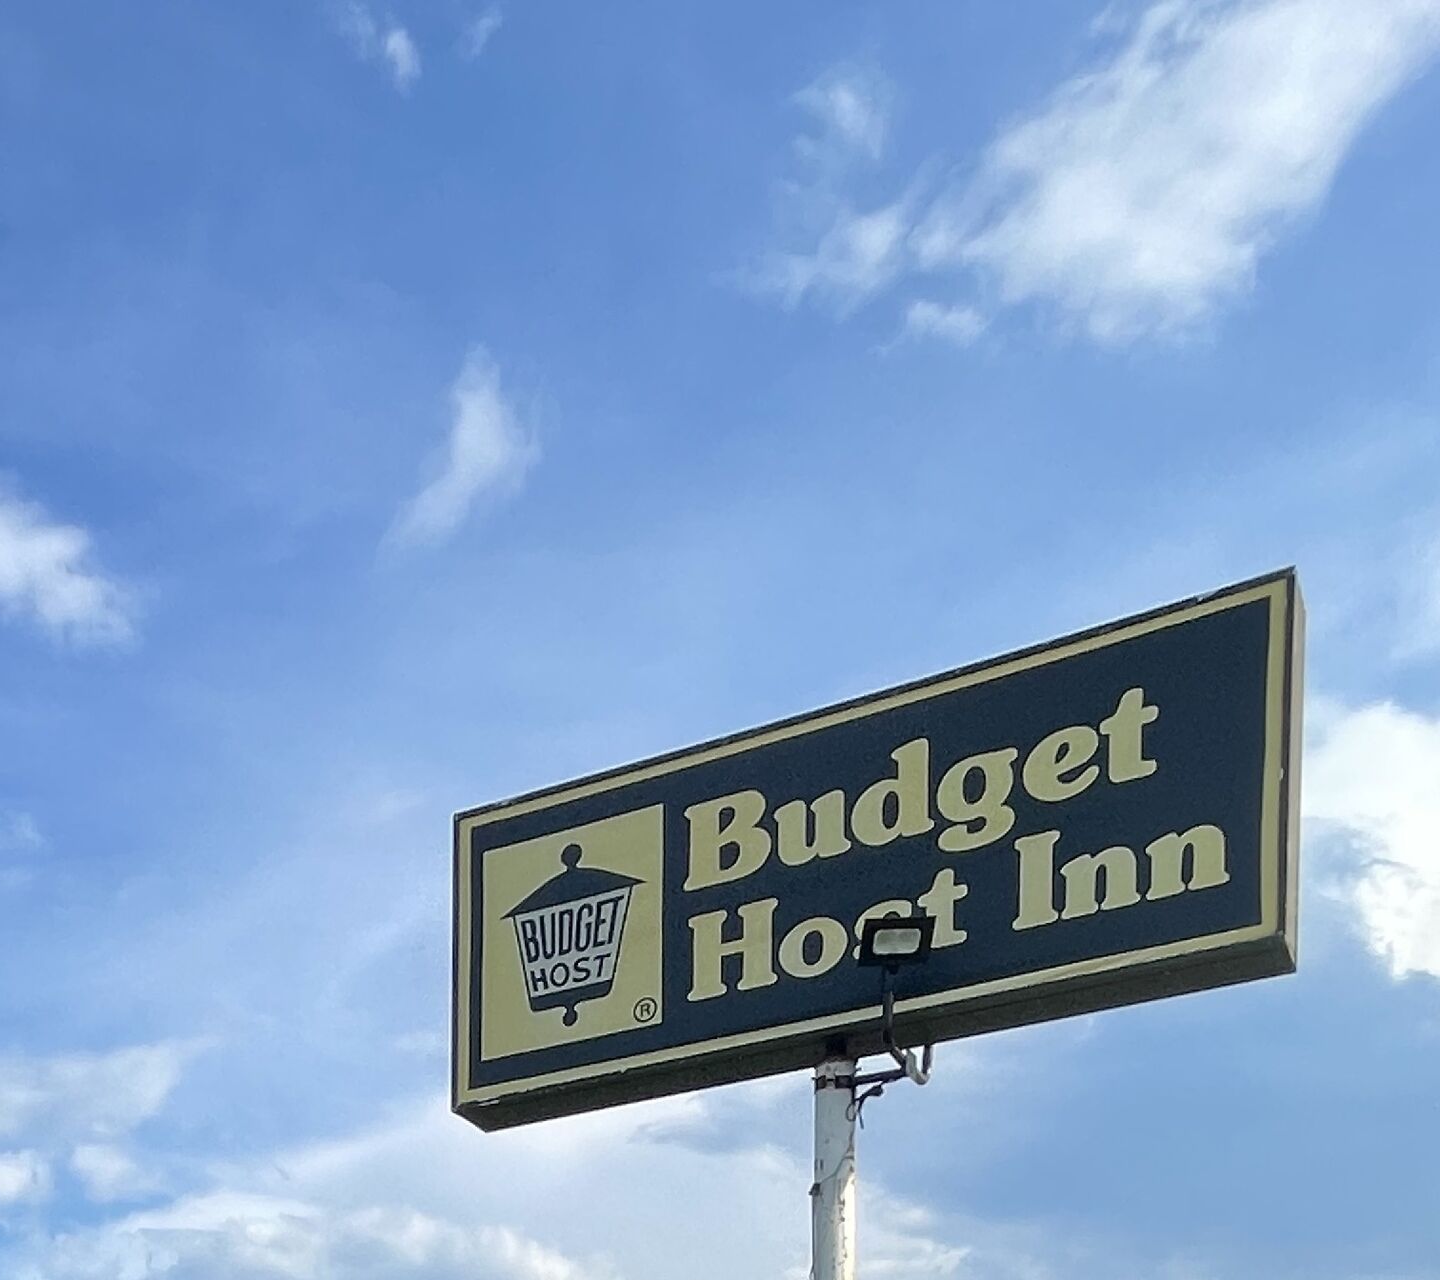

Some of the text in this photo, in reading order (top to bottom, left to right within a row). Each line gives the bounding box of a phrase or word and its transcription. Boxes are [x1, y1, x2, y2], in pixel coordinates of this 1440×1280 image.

[682, 687, 1159, 892] Budget
[1012, 824, 1231, 931] Inn
[520, 895, 625, 964] BUDGET
[530, 953, 612, 992] HOST
